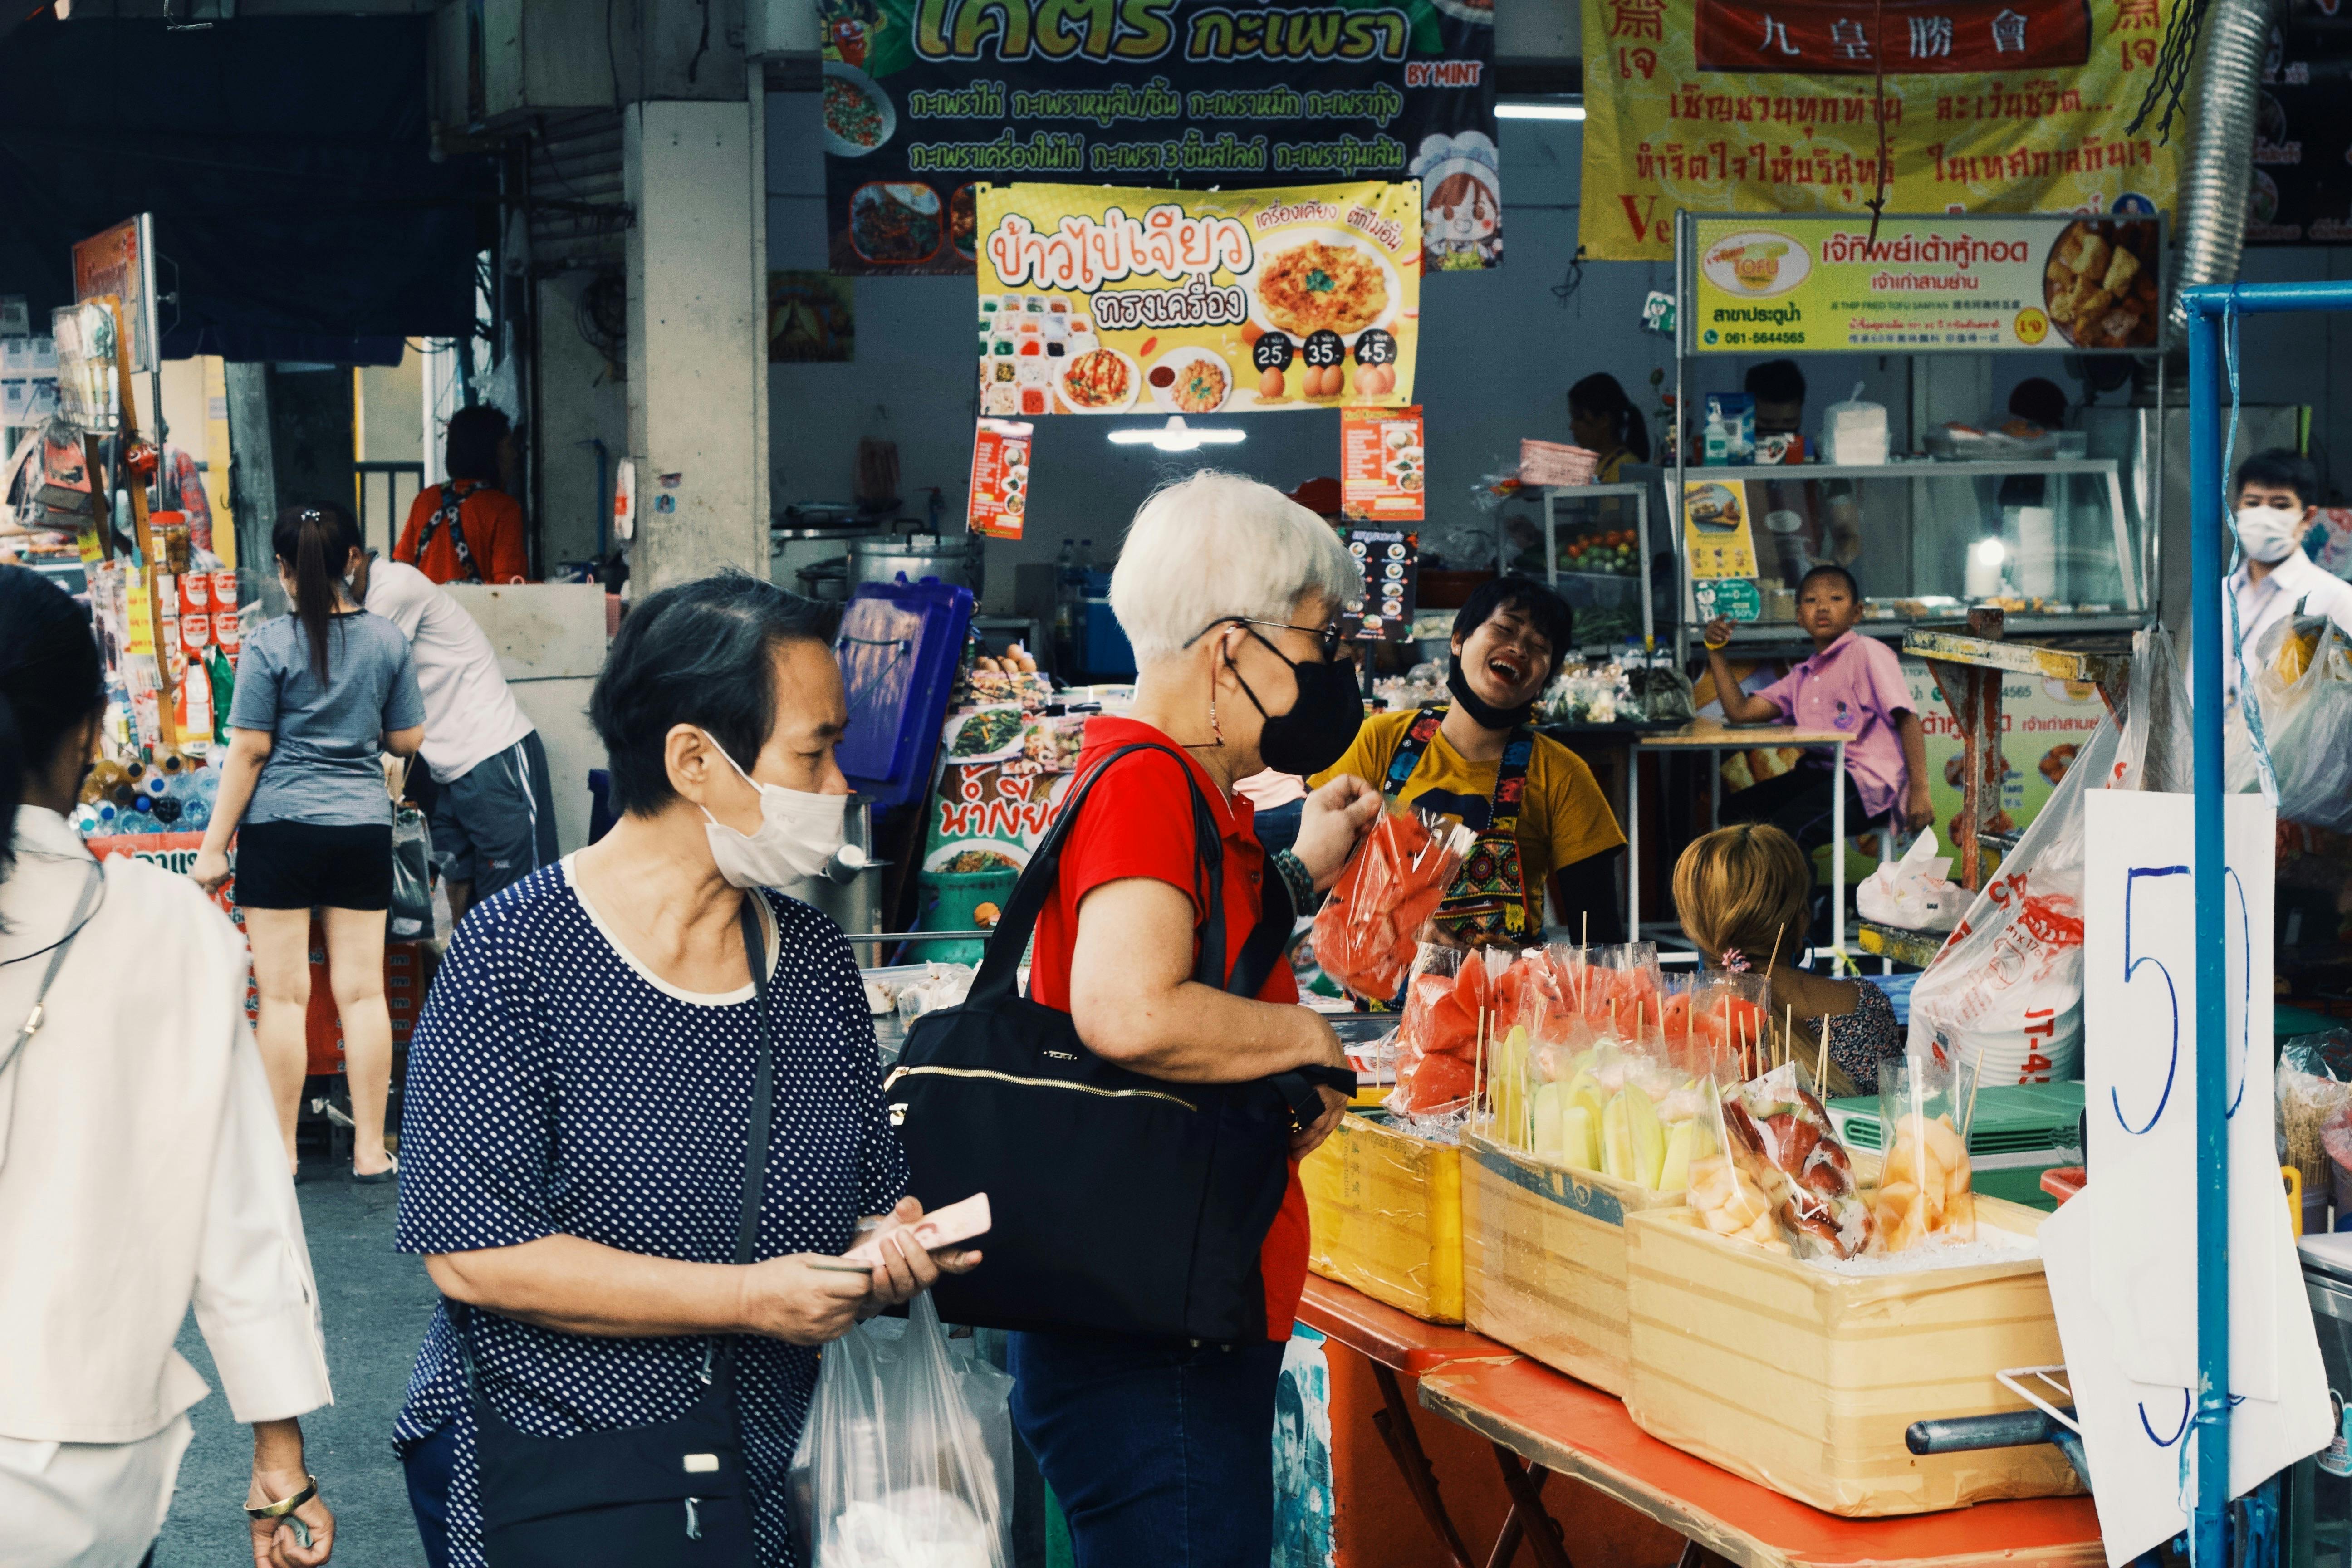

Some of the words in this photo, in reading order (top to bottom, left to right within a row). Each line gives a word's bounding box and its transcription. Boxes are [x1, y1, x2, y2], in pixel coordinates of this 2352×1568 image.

[1191, 11, 1406, 58] กะเพรา
[1619, 47, 1657, 80] เจ
[2121, 39, 2157, 71] เจ
[1407, 64, 1431, 85] BY
[1434, 62, 1481, 85] MINT
[912, 83, 1003, 115] กะเพราไก่
[1190, 85, 1300, 115] กะเพราหมึก
[1307, 84, 1401, 123] กะเพรากุ้ง
[911, 132, 1080, 167] กะเพราเครื่องในไก่
[994, 211, 1243, 284] ข้าวไข่เจียว
[1734, 258, 1779, 275] TOFU
[1872, 272, 1979, 290] เจ้าเก่าสามย่าน
[1095, 272, 1240, 323] ทรงเครื่อง
